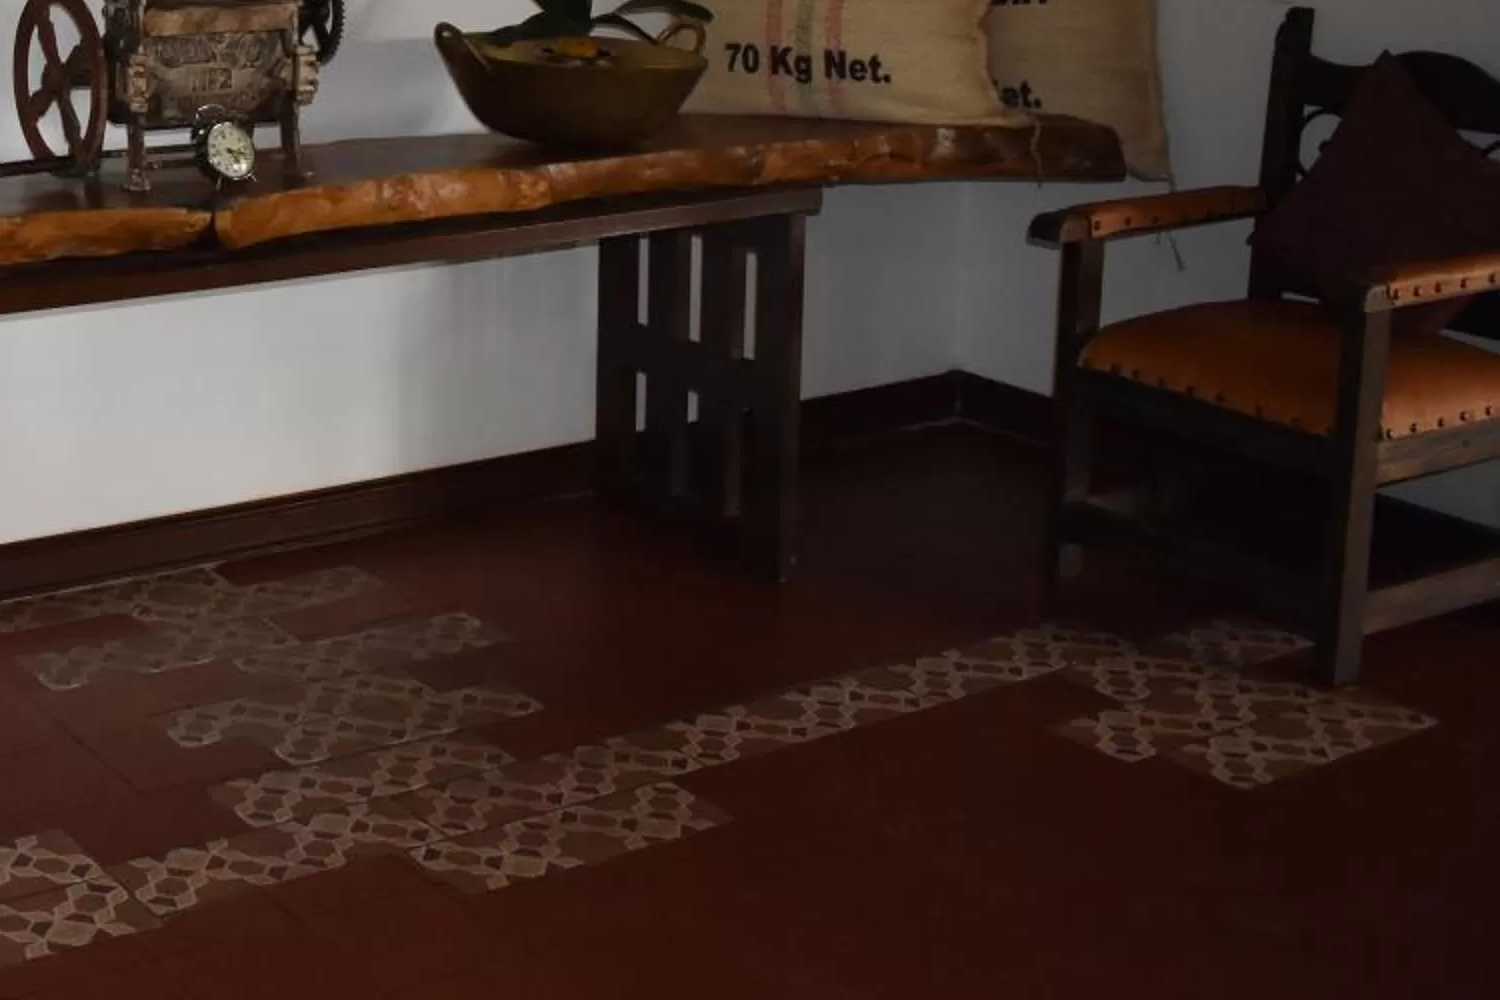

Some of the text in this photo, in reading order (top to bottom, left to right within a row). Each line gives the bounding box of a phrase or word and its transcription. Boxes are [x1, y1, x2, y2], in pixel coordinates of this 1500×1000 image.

[725, 43, 891, 84] 70 Kg Net.
[993, 79, 1043, 109] et.
